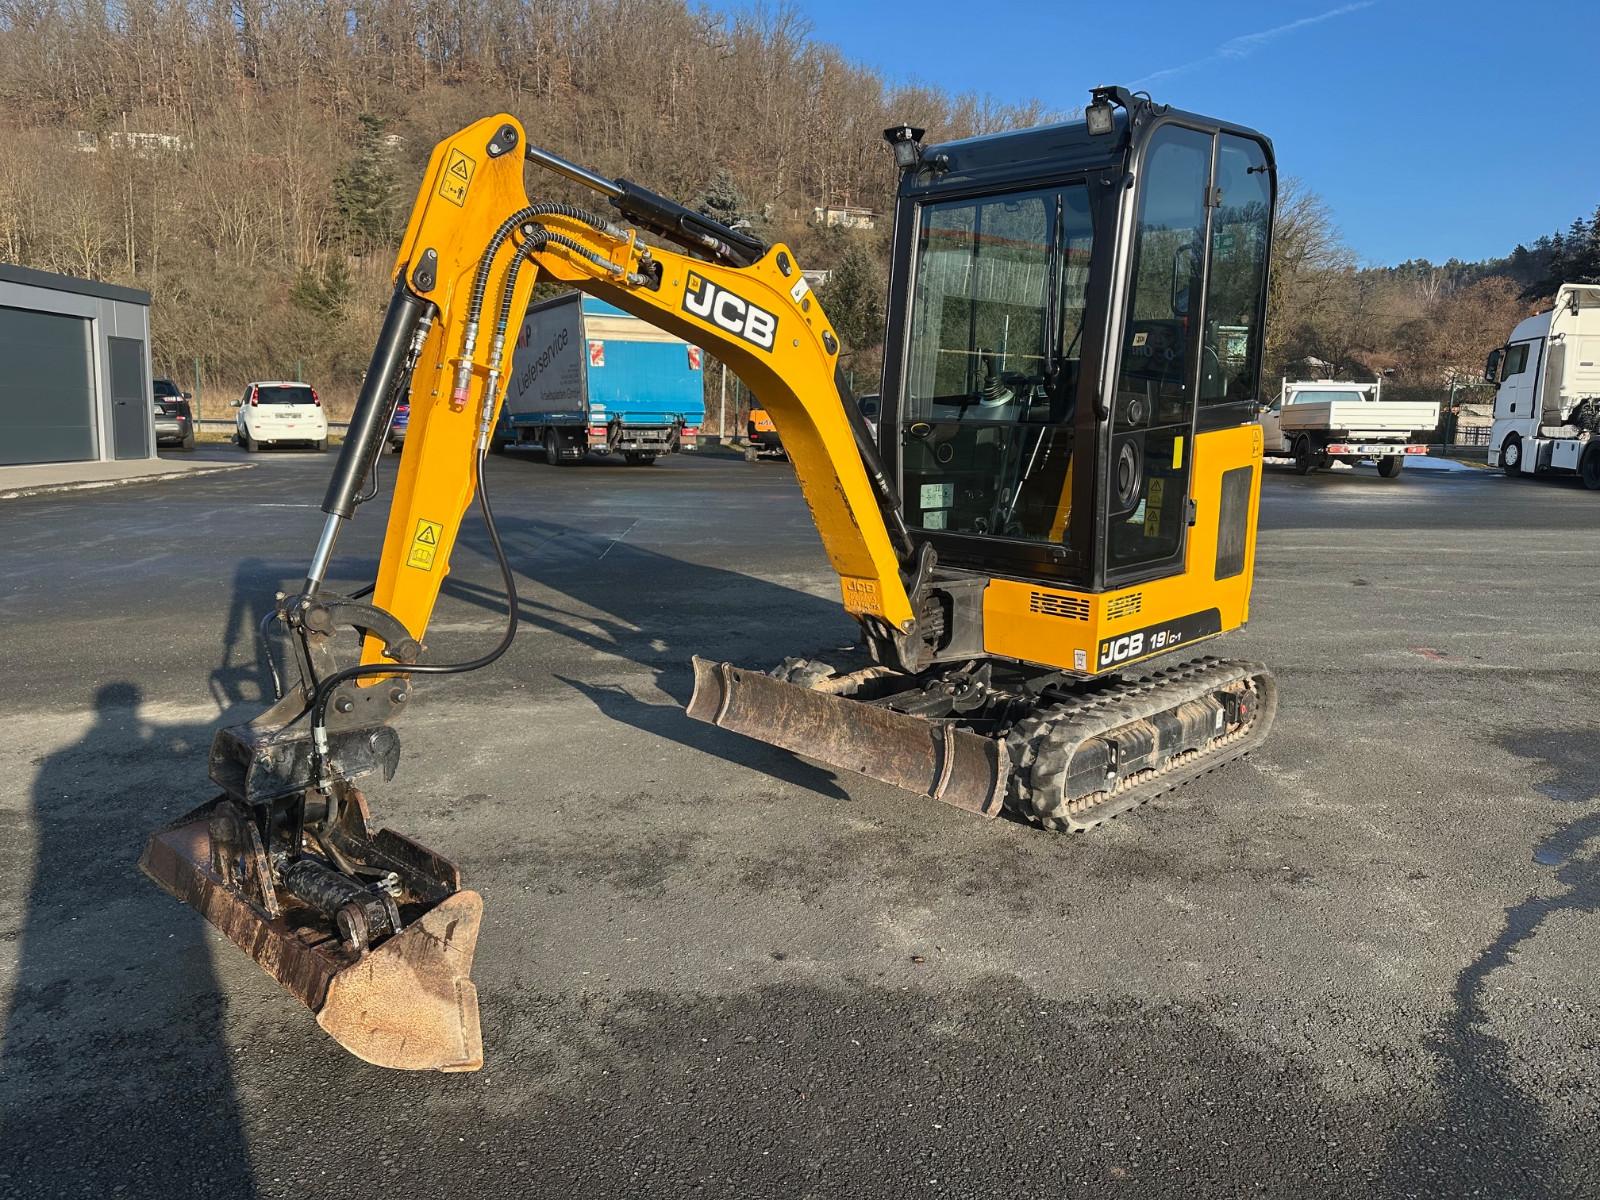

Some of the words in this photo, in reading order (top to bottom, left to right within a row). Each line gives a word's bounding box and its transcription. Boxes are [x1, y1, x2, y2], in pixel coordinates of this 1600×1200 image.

[685, 282, 776, 348] JCB
[516, 327, 569, 397] Lieferservice
[1100, 632, 1144, 665] JCB
